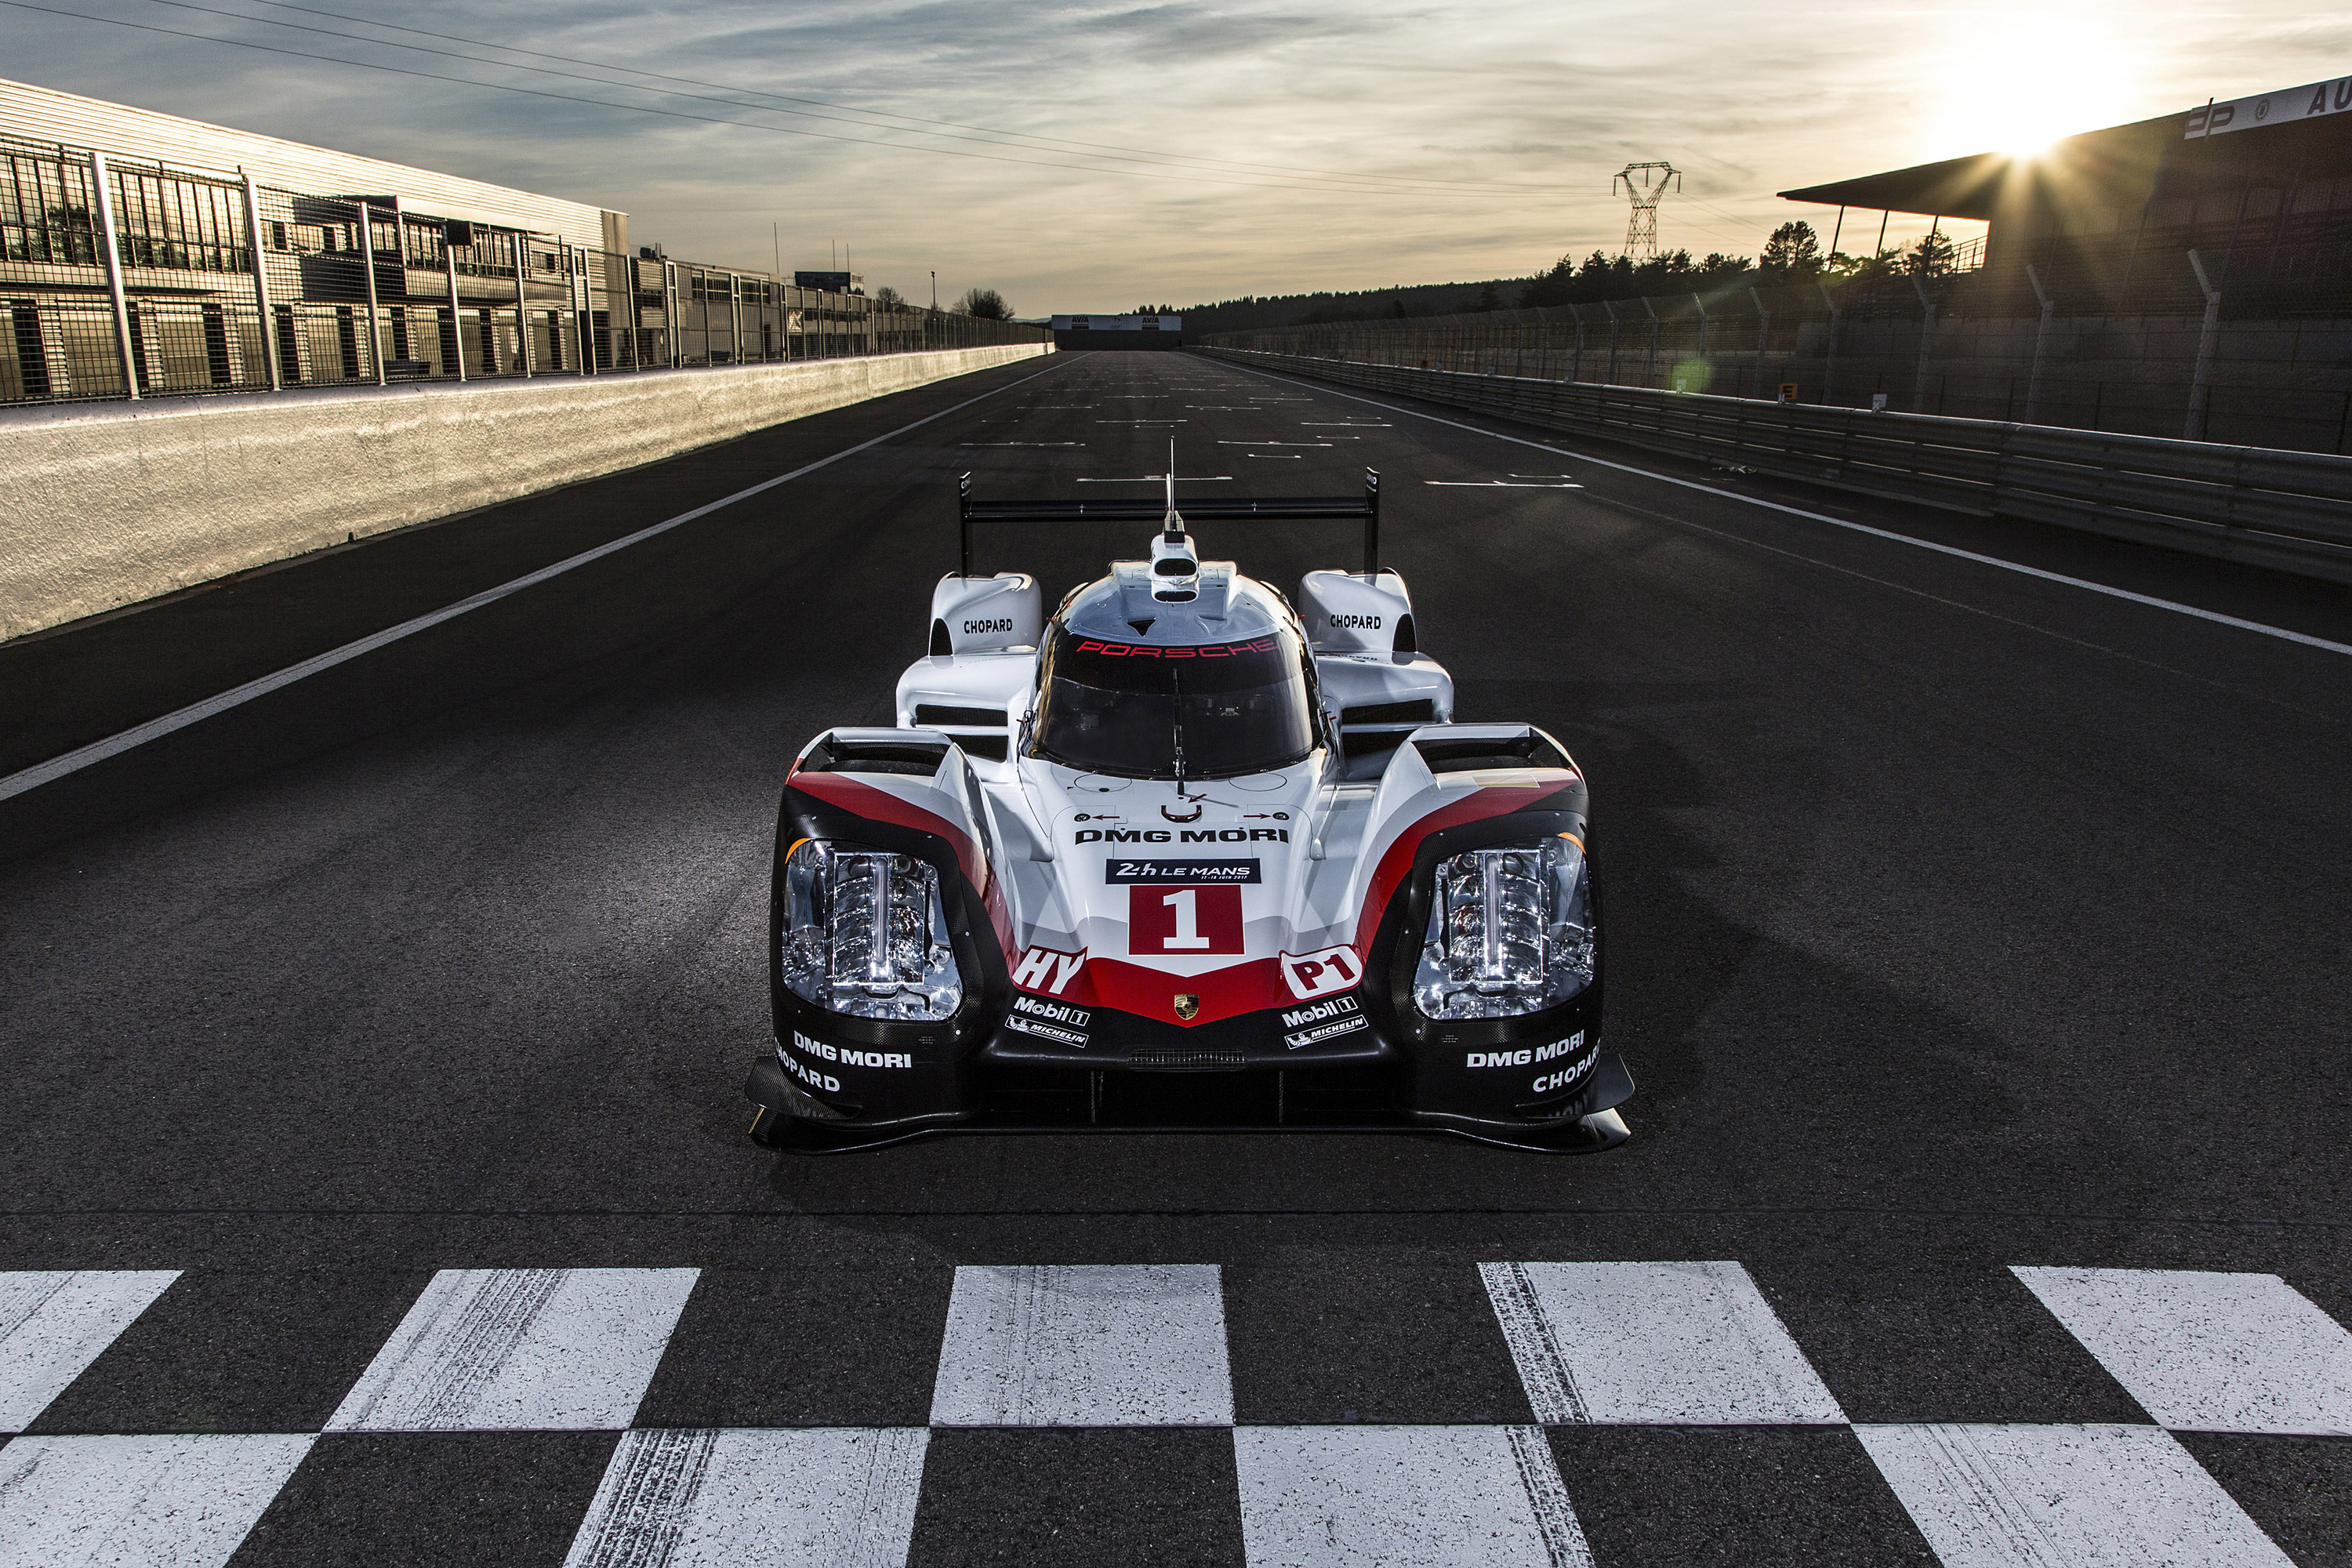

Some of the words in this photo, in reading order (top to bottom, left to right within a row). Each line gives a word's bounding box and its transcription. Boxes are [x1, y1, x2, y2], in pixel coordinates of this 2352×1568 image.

[1783, 386, 1793, 397] E
[964, 619, 1013, 633] CHOPARD
[1330, 614, 1381, 630] CHOPARD
[1076, 638, 1279, 658] PORSCHE
[1075, 829, 1172, 845] DMG
[1180, 828, 1289, 844] MORI
[1161, 867, 1187, 877] LE
[1190, 867, 1250, 877] MANS
[1163, 889, 1210, 949] 1
[1011, 948, 1086, 995] HY
[1290, 953, 1356, 991] P1
[1014, 996, 1070, 1022] Mobil
[1282, 1001, 1339, 1028] Mobil
[1030, 1024, 1086, 1043] MICHELIN
[1311, 1018, 1363, 1038] MICHELIN
[793, 1030, 837, 1061] DMG
[840, 1048, 912, 1068] MORI
[1467, 1050, 1531, 1068] DMG
[1535, 1029, 1584, 1062] MORI
